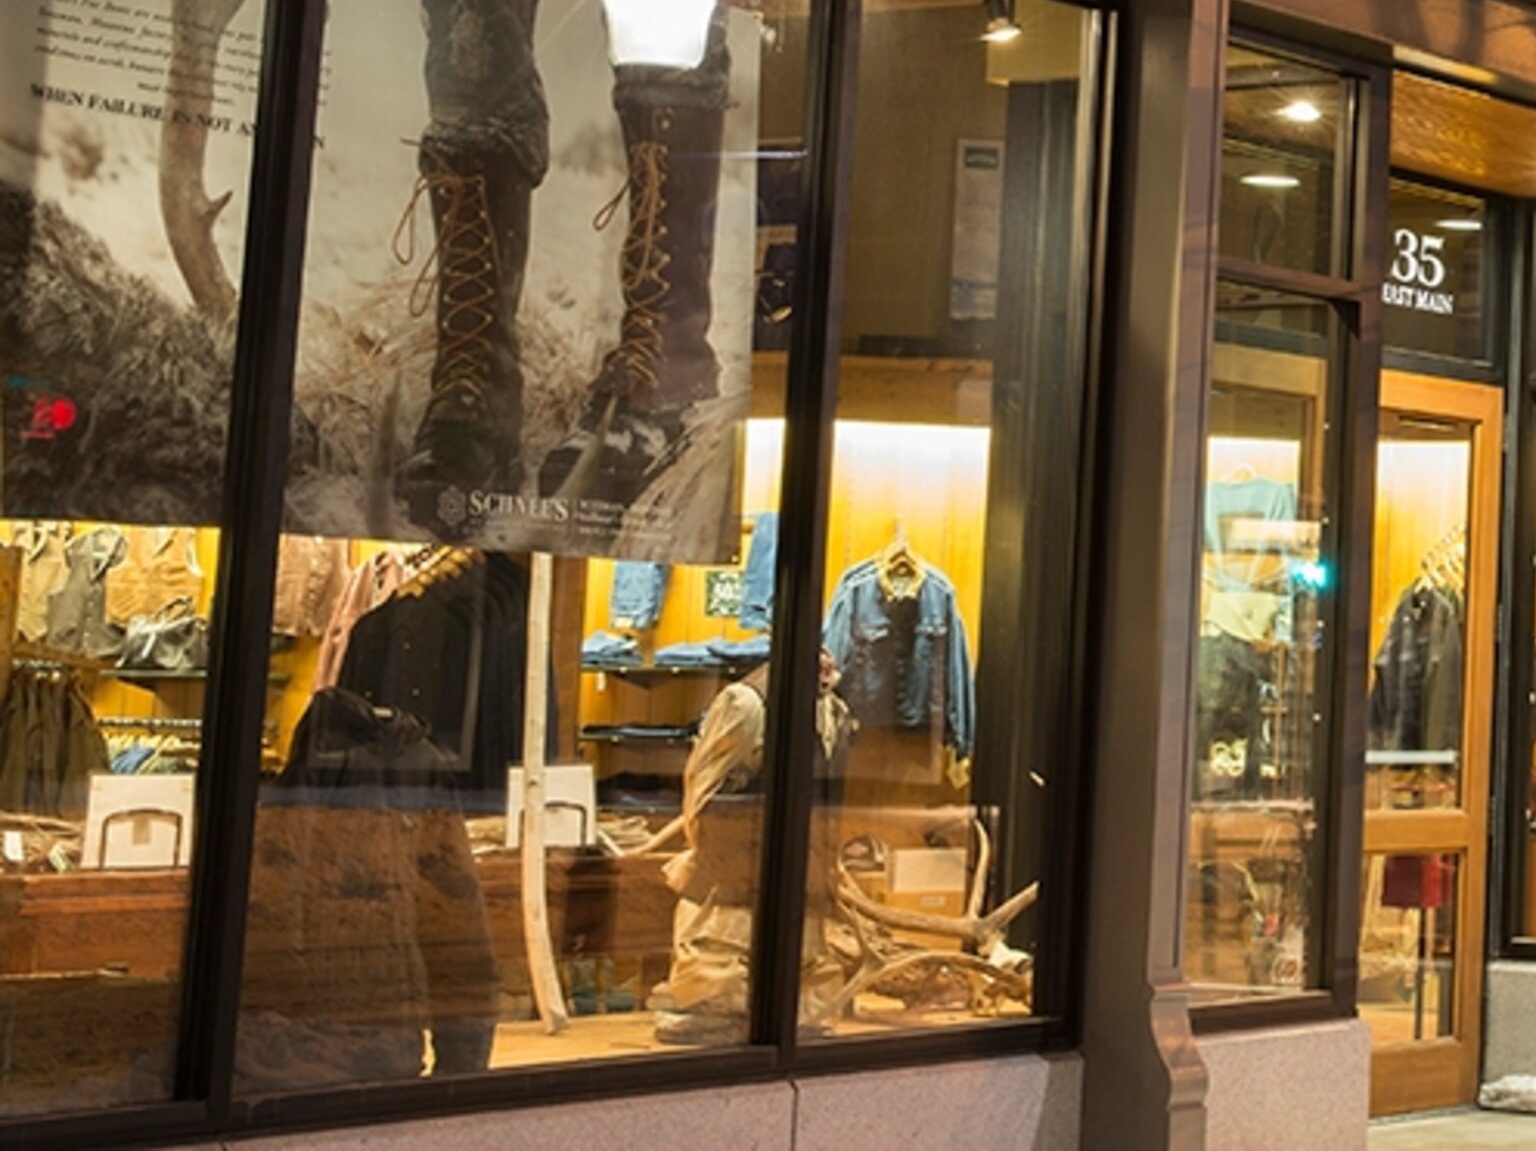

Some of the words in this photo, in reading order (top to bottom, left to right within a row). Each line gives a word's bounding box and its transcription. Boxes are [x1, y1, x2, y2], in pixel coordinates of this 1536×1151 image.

[30, 83, 85, 107] WHEN
[87, 94, 166, 123] FAILURE
[1391, 228, 1447, 287] 35
[1415, 290, 1454, 315] MAIN
